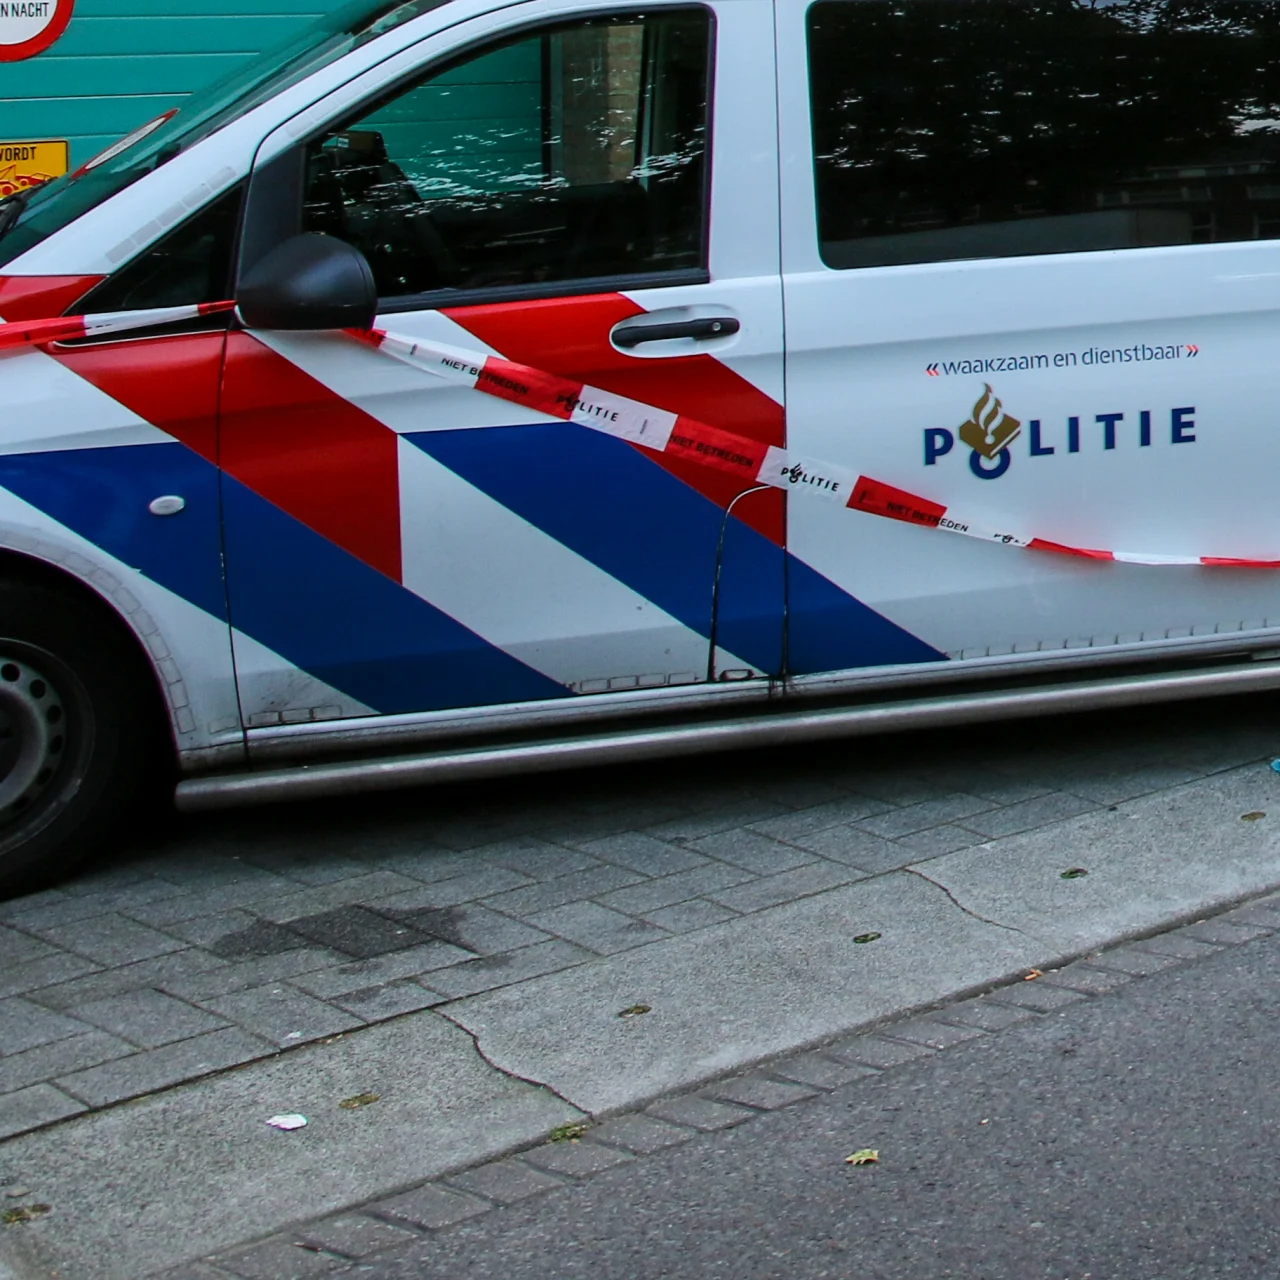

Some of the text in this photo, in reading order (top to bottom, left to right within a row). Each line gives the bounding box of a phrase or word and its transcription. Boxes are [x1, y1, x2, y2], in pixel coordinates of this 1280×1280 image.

[11, 2, 49, 18] NACHT
[441, 357, 468, 372] NIET
[943, 355, 1049, 376] waakzaam
[1053, 352, 1077, 367] en
[1082, 344, 1184, 365] dienstbaar
[924, 406, 1197, 480] POLITIE
[781, 466, 840, 492] POLITIE
